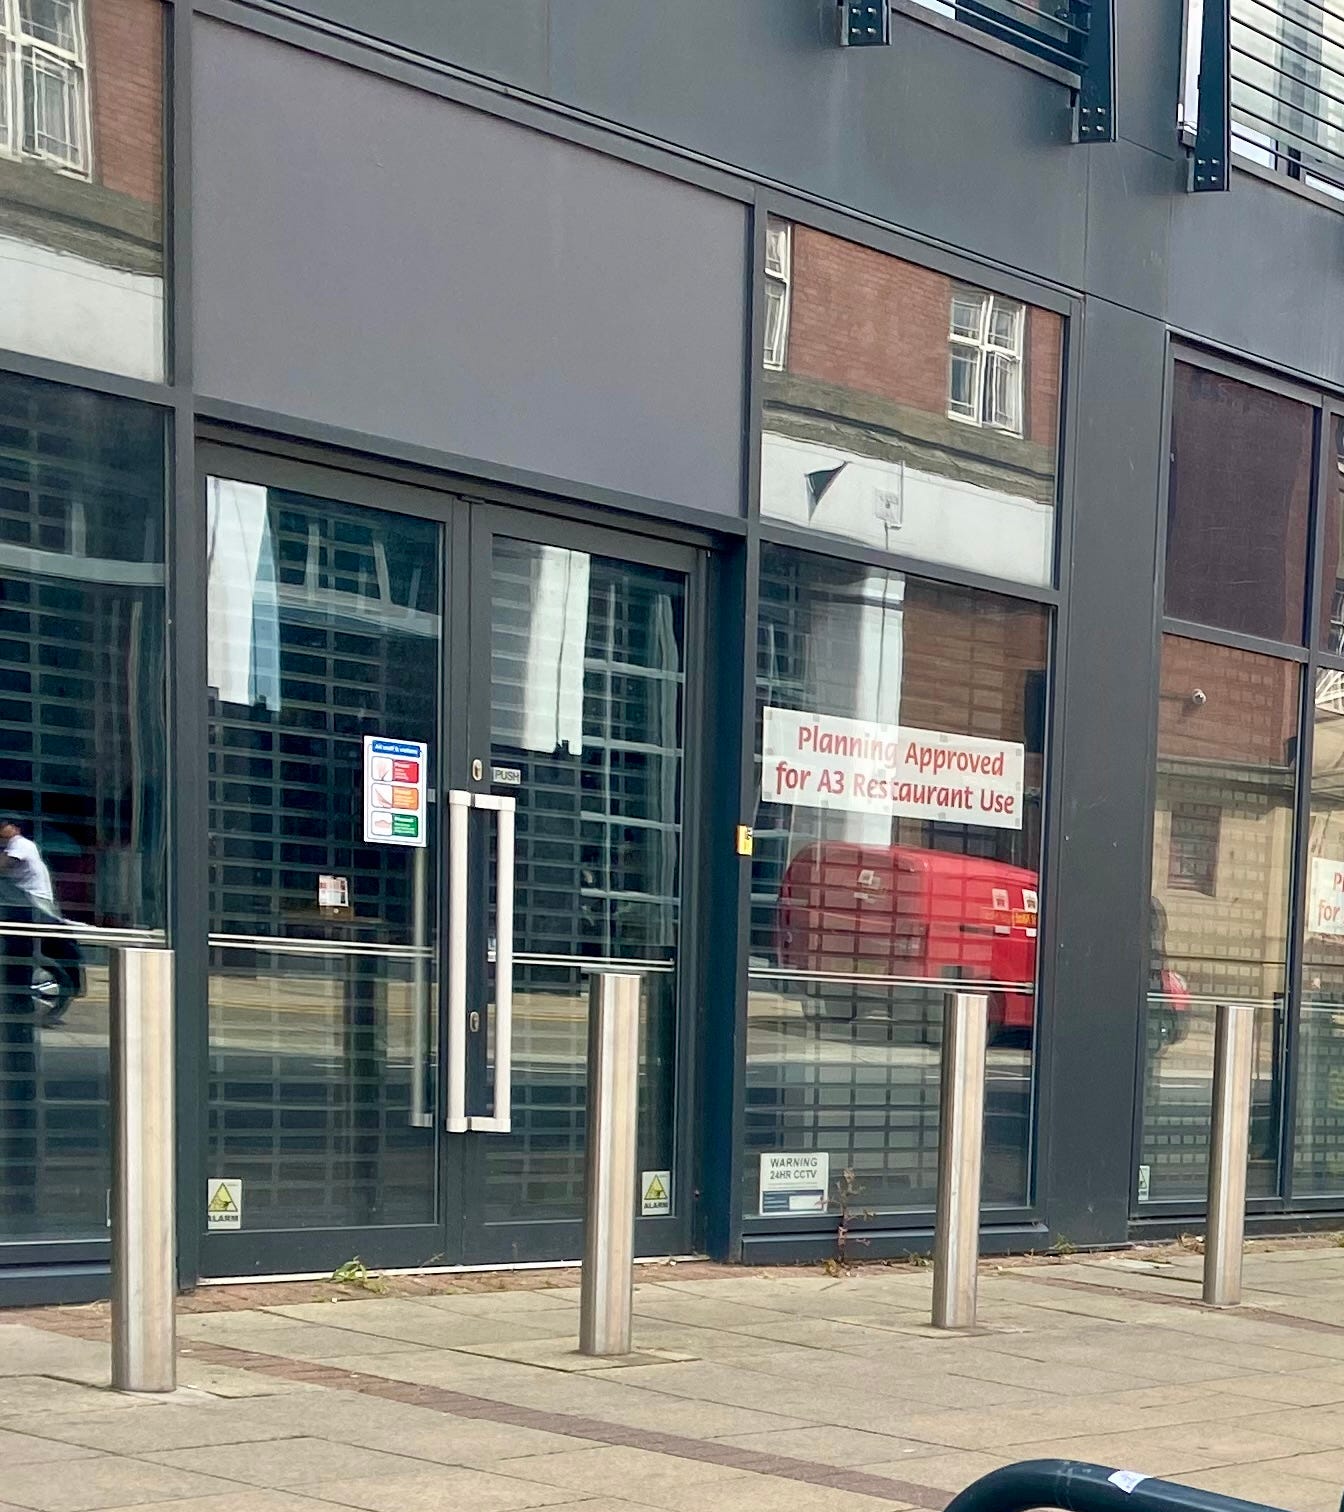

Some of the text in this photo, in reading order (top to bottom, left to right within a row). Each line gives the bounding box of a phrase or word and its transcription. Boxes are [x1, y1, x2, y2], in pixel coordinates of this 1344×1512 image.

[798, 725, 1004, 777] Planning Approved
[495, 770, 519, 782] PUSH
[776, 761, 1015, 814] for A3 Restaurant Use
[1318, 899, 1340, 926] for
[770, 1157, 818, 1168] WARNING
[770, 1169, 817, 1180] 24HR CCTV
